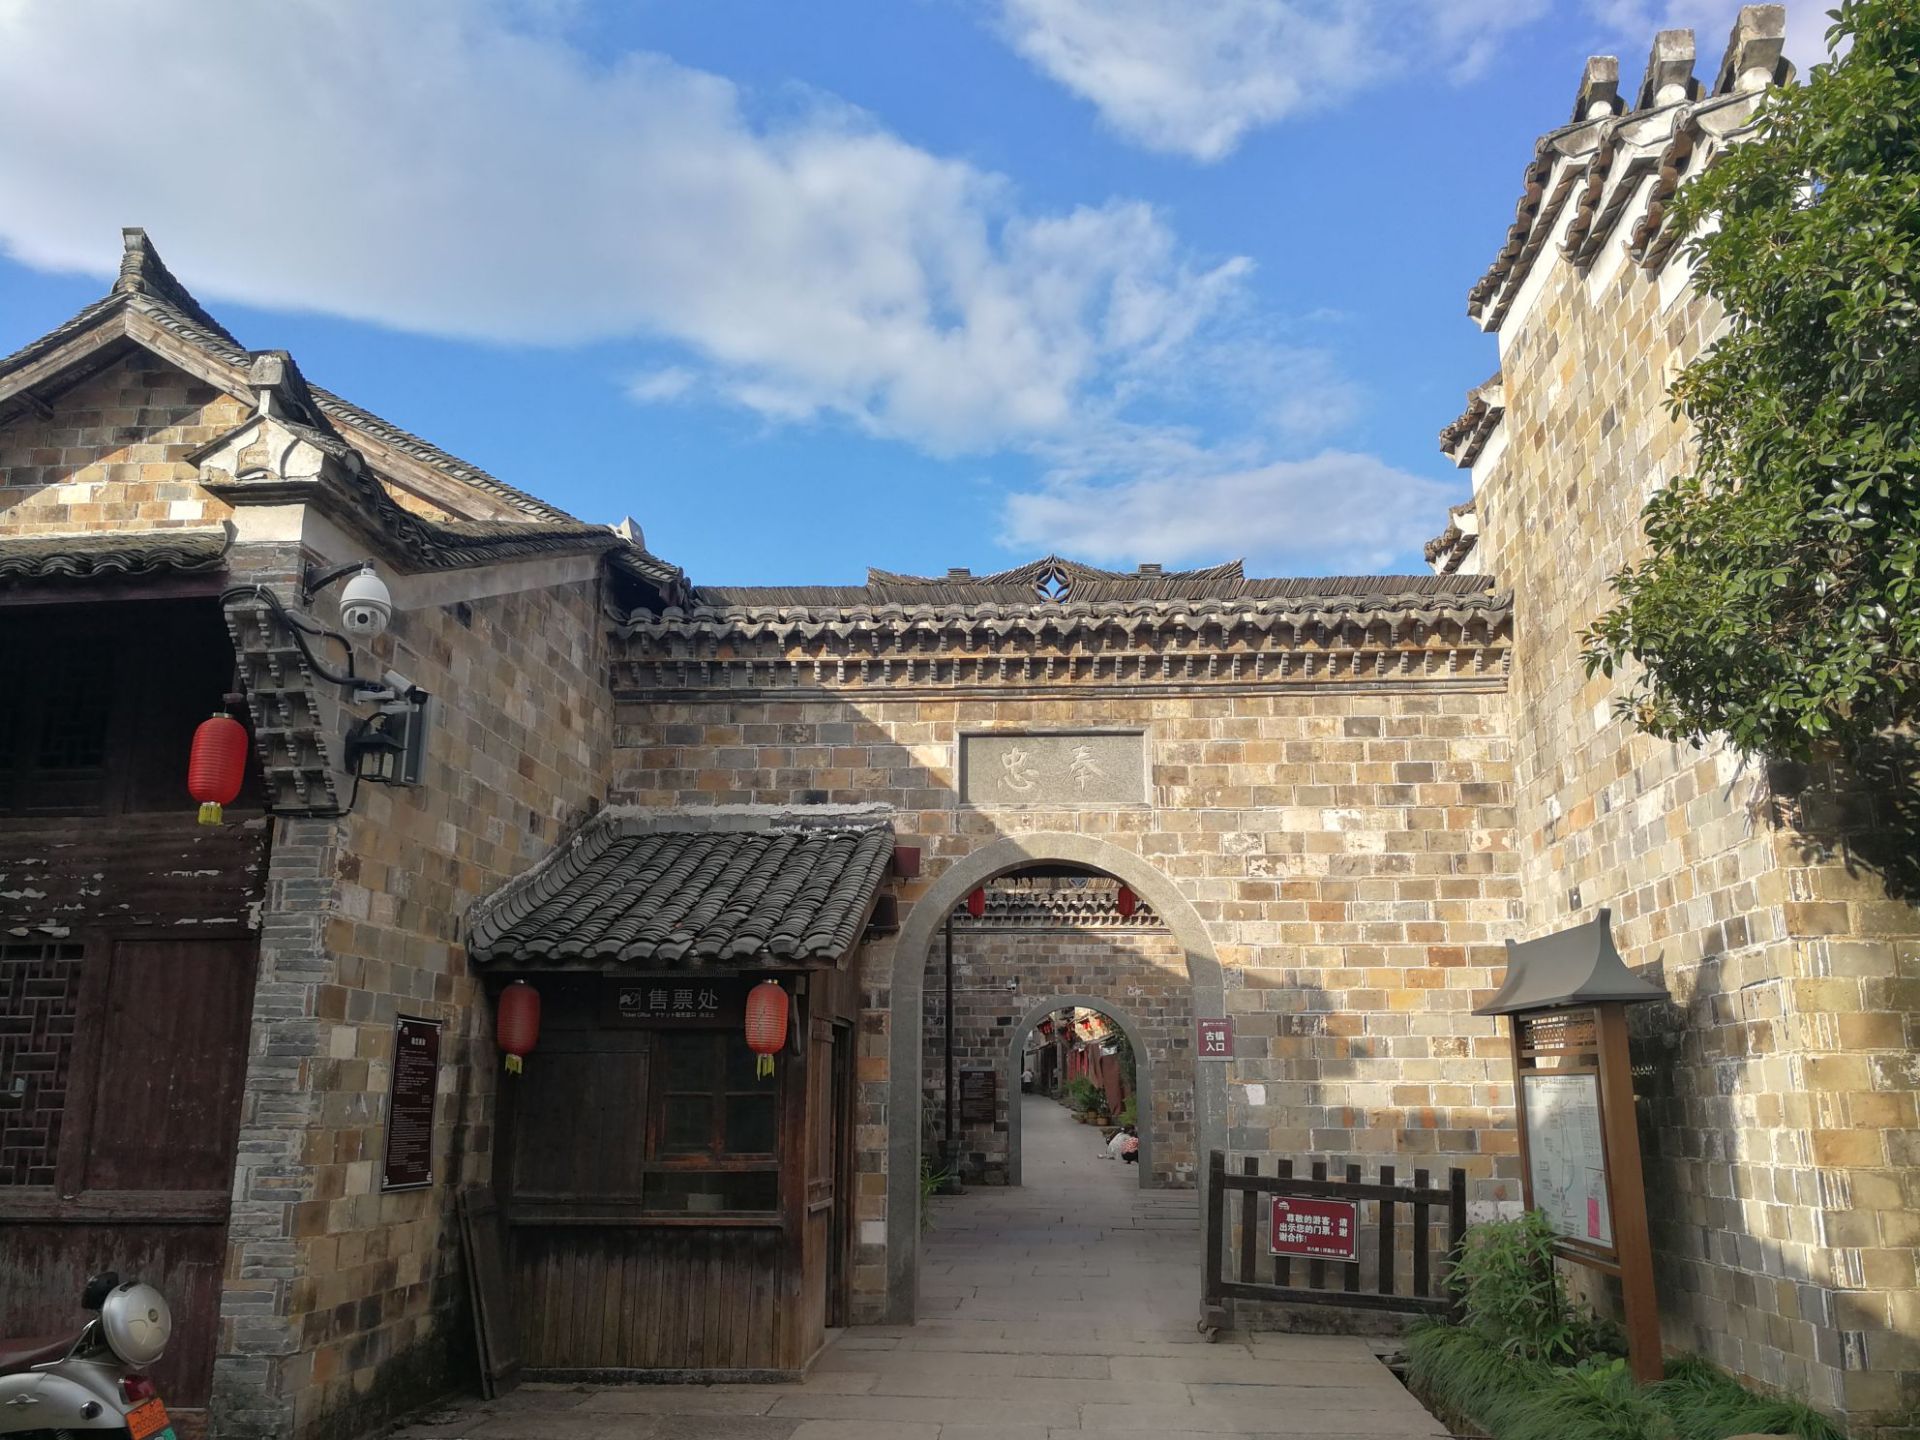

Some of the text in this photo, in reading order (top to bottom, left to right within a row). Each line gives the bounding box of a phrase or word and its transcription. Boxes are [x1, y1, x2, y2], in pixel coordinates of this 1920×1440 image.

[648, 988, 719, 1010] 售票处
[1205, 1031, 1225, 1041] 古镇
[1206, 1042, 1225, 1052] 入口
